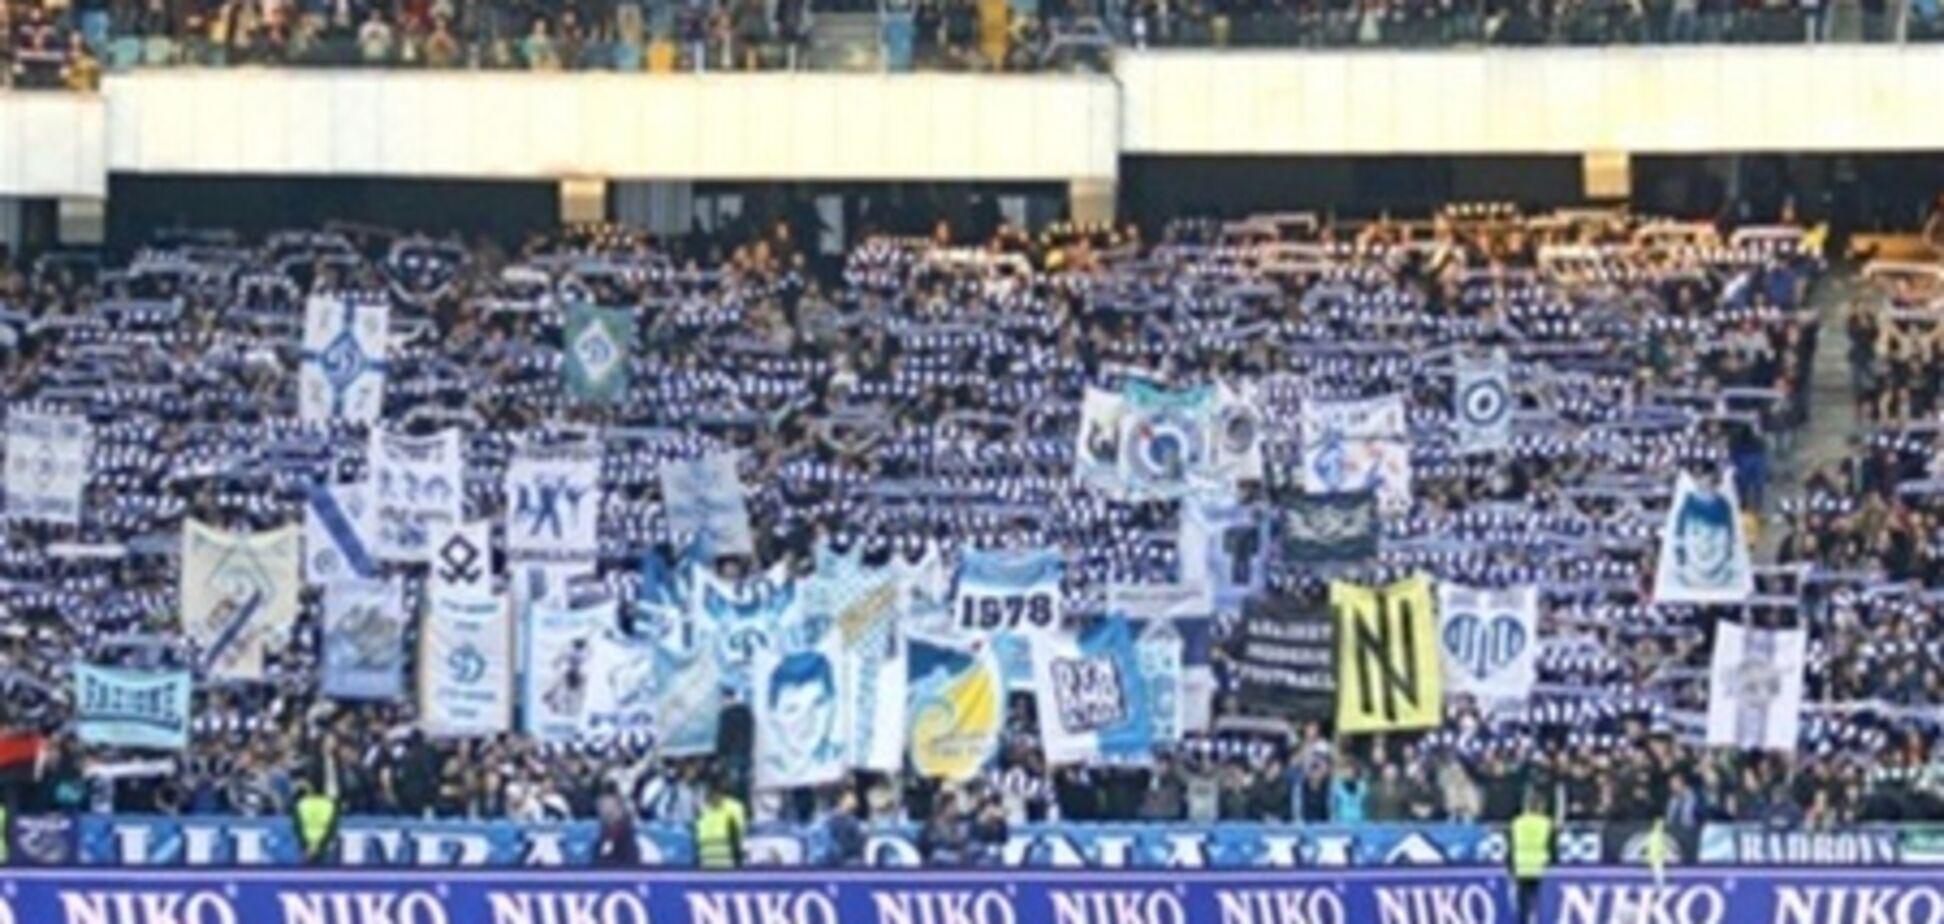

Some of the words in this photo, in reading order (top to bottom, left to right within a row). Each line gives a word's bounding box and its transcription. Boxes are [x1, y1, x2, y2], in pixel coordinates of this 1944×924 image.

[962, 594, 1052, 628] 1978
[58, 891, 236, 924] NIKO
[277, 891, 447, 924] NIKO
[486, 891, 648, 924] NIKO
[685, 890, 838, 924] NIKO
[872, 890, 1015, 924] NIKO
[1049, 890, 1186, 924] NIKO
[1216, 888, 1345, 924] NIKO
[1374, 885, 1496, 924] NIKO
[1773, 885, 1944, 924] NIKO
